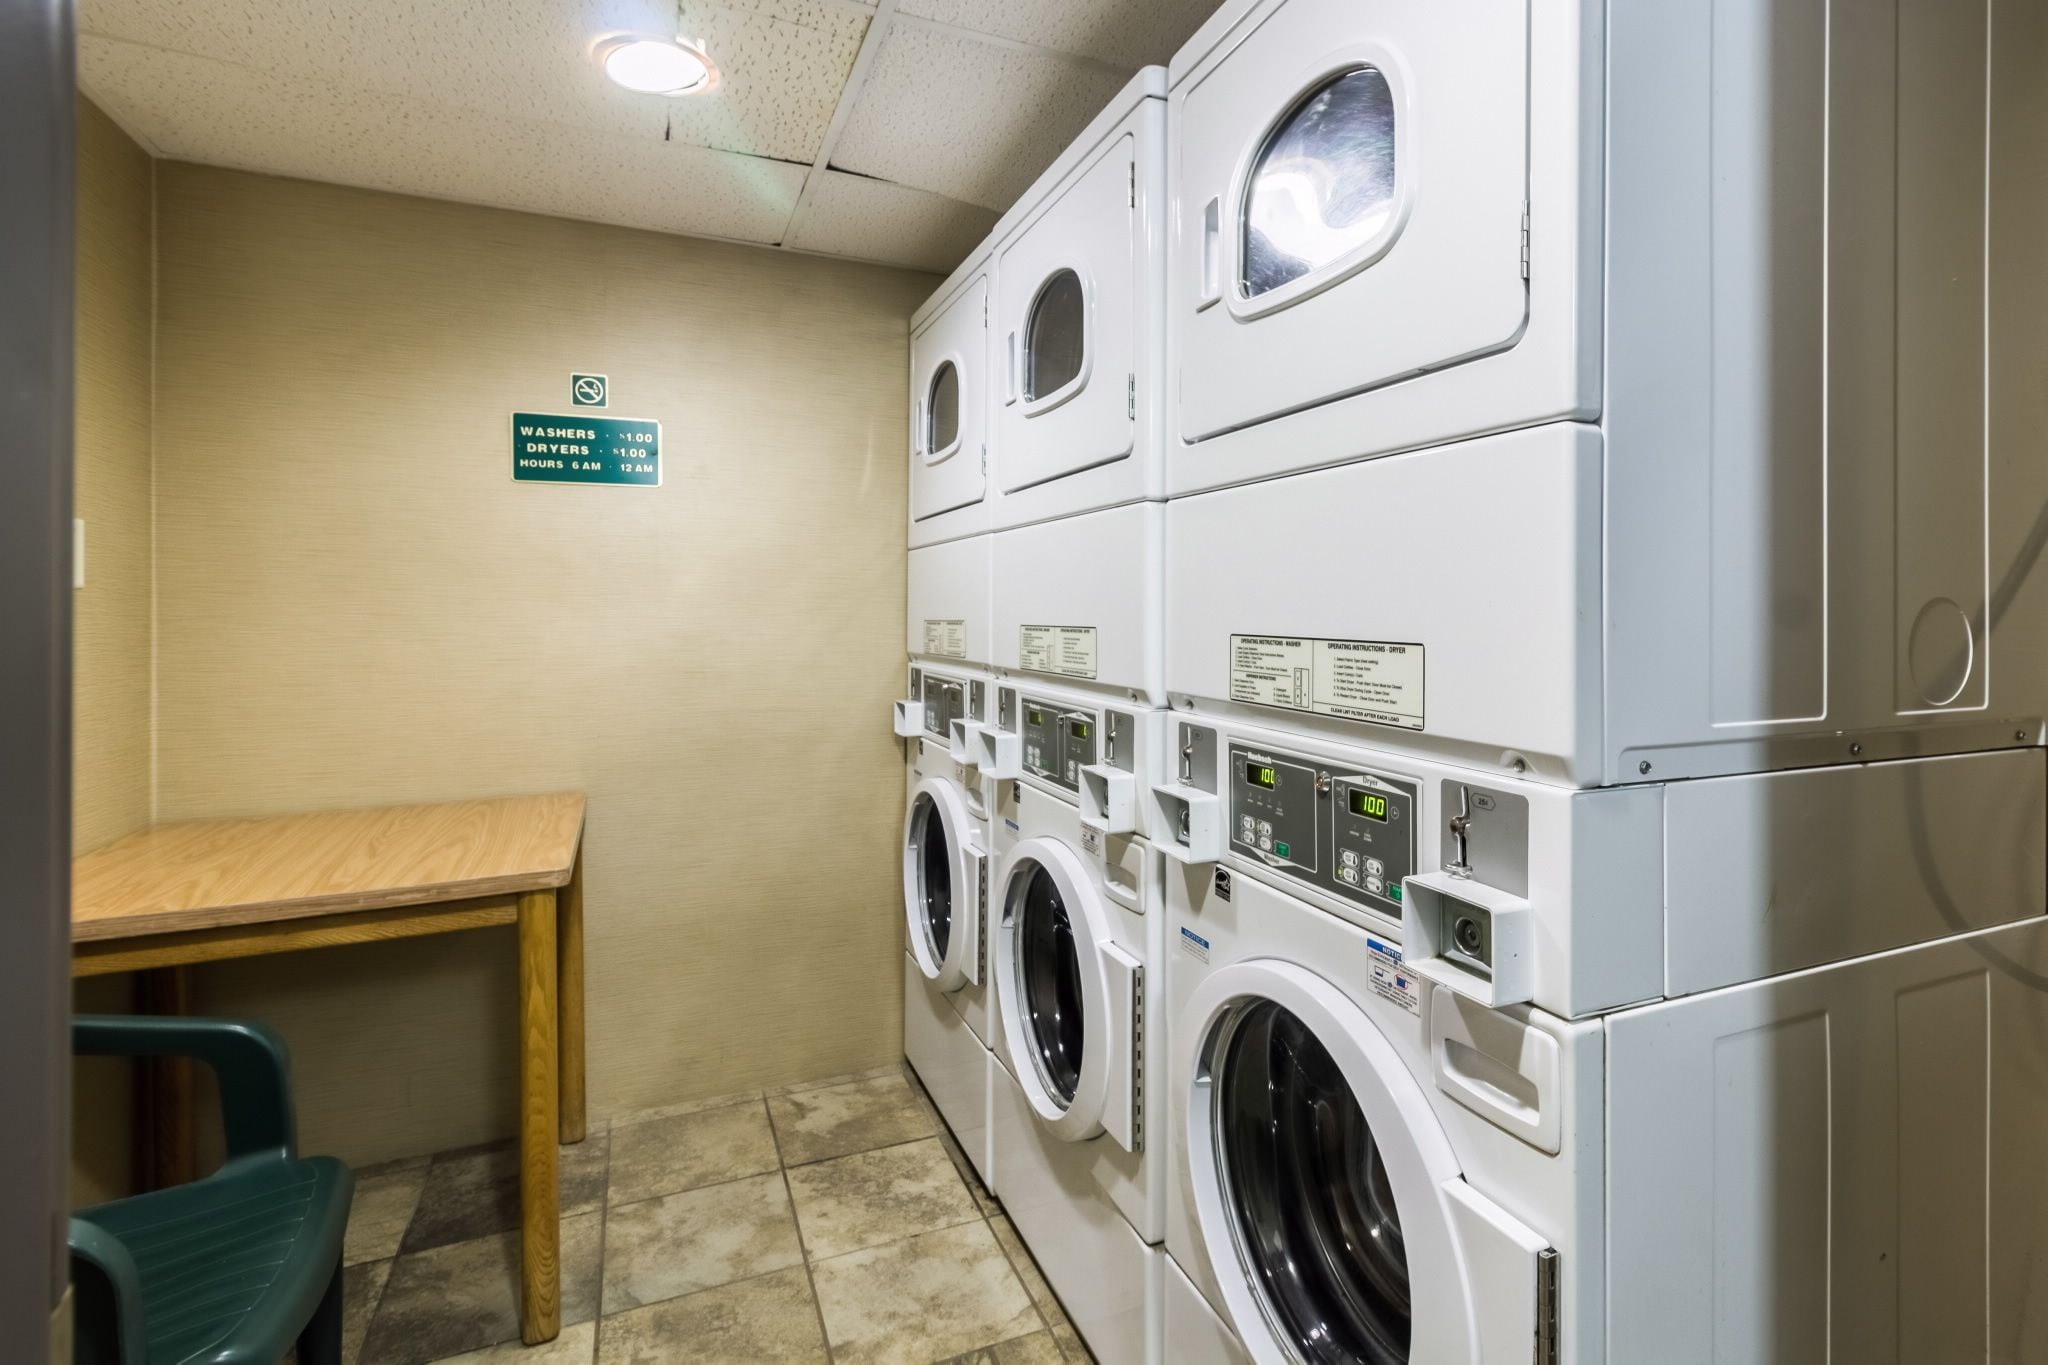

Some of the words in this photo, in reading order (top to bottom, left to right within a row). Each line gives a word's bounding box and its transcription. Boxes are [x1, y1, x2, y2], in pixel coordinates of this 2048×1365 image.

[520, 426, 596, 440] WASHERS
[619, 432, 653, 443] $1.00
[526, 443, 590, 455] DRYERS
[613, 447, 647, 458] $1.00
[519, 459, 564, 469] HOURS
[572, 461, 579, 470] 6
[582, 462, 601, 470] AM
[620, 464, 632, 472] 12
[635, 464, 653, 473] AM
[1327, 643, 1352, 651] OPERATING
[1352, 644, 1386, 653] INSTRUCTIONS
[1389, 646, 1406, 654] DRYER
[1362, 776, 1378, 787] Dryer
[1363, 795, 1385, 816] 100
[1382, 946, 1401, 960] NOTIC
